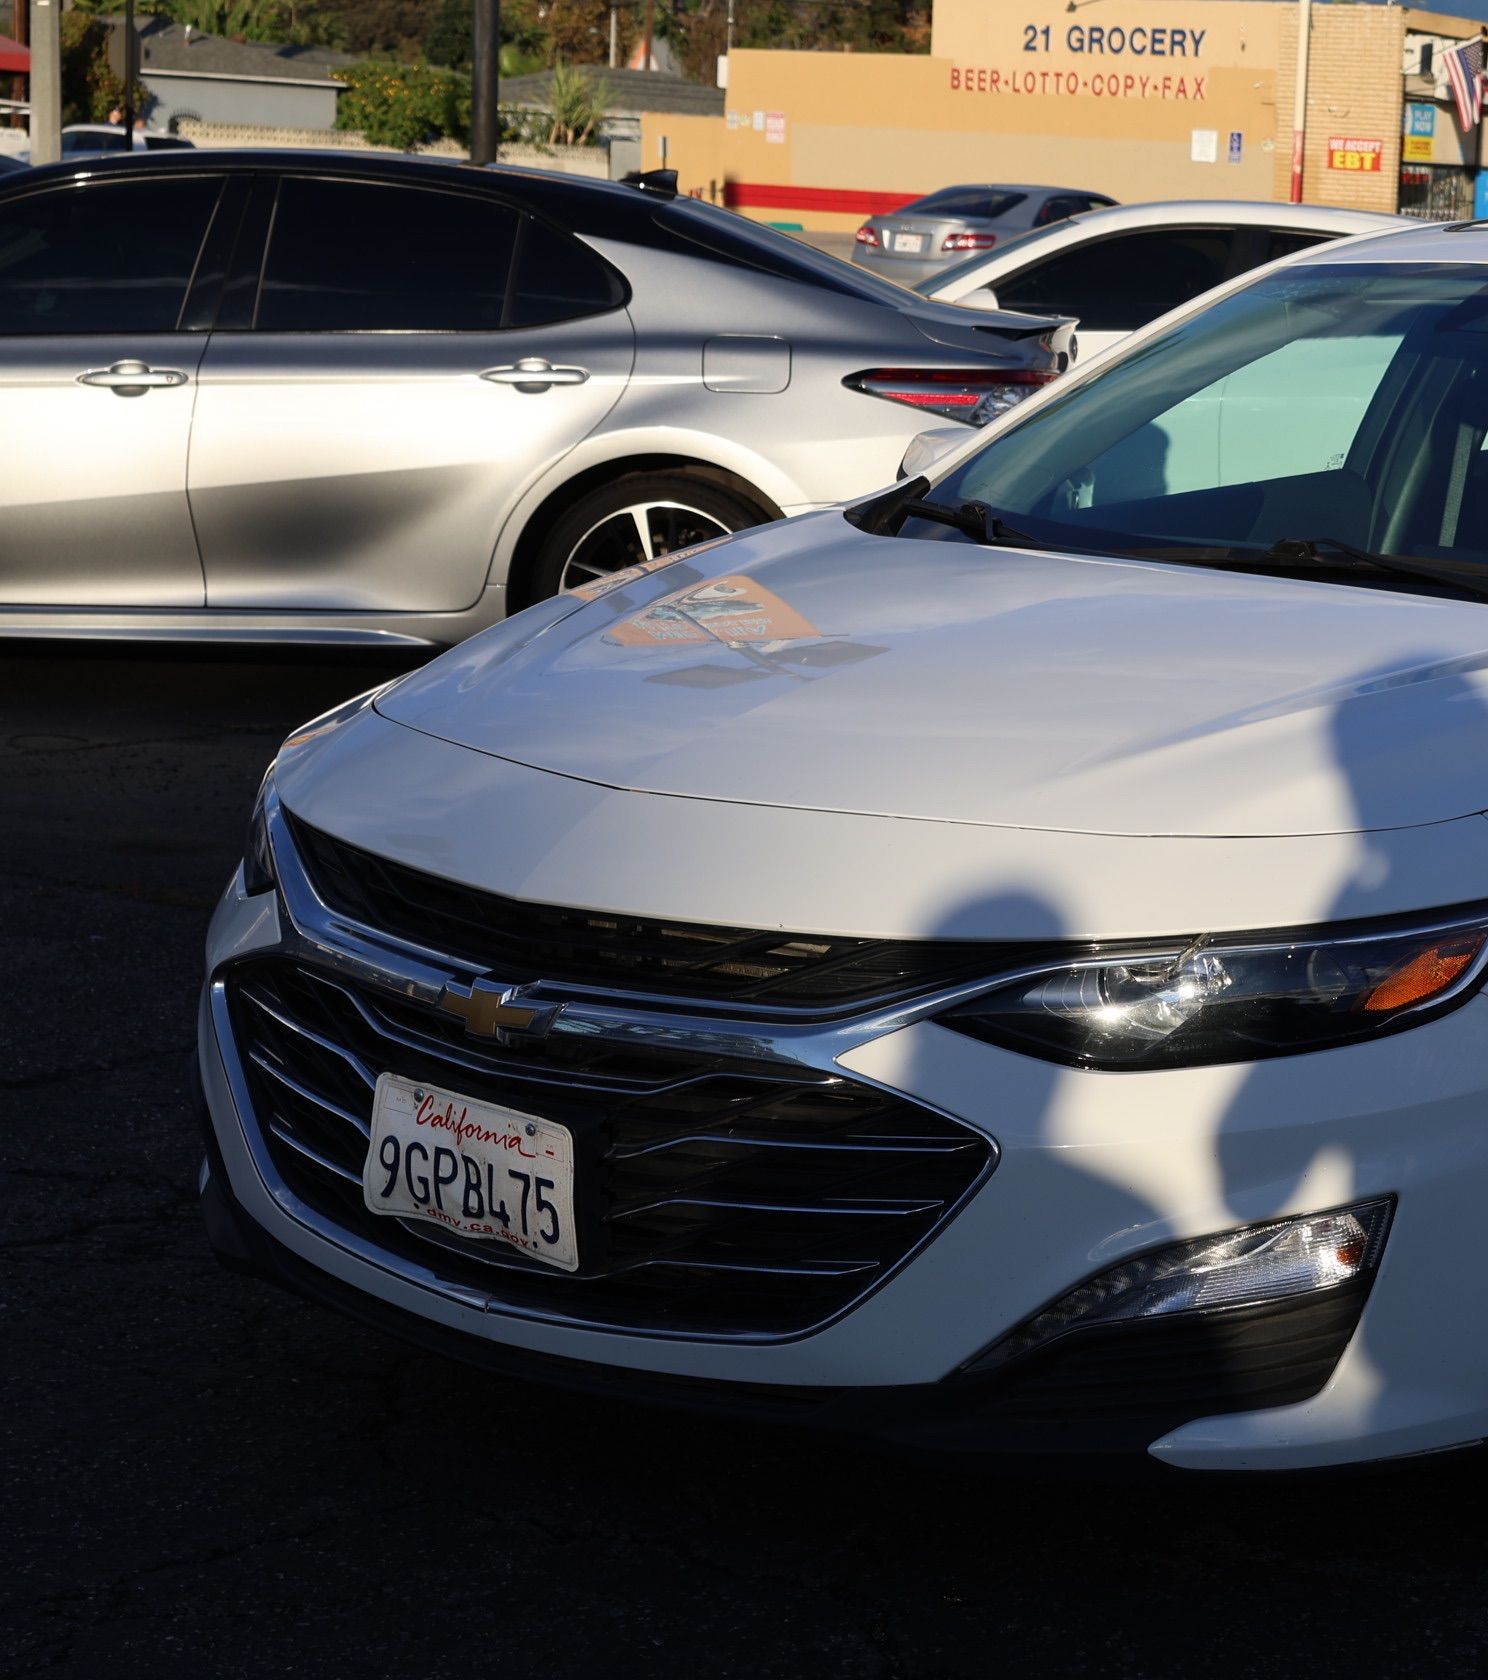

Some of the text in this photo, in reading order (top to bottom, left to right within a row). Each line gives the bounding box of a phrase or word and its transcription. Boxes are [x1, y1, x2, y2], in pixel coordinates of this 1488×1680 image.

[1023, 25, 1206, 57] 21 GROCERY
[1162, 77, 1206, 100] FAX
[1332, 151, 1377, 170] EBT
[415, 1094, 536, 1158] California
[379, 1135, 561, 1245] 9GPB475
[427, 1208, 530, 1246] dmv.ca.gov
